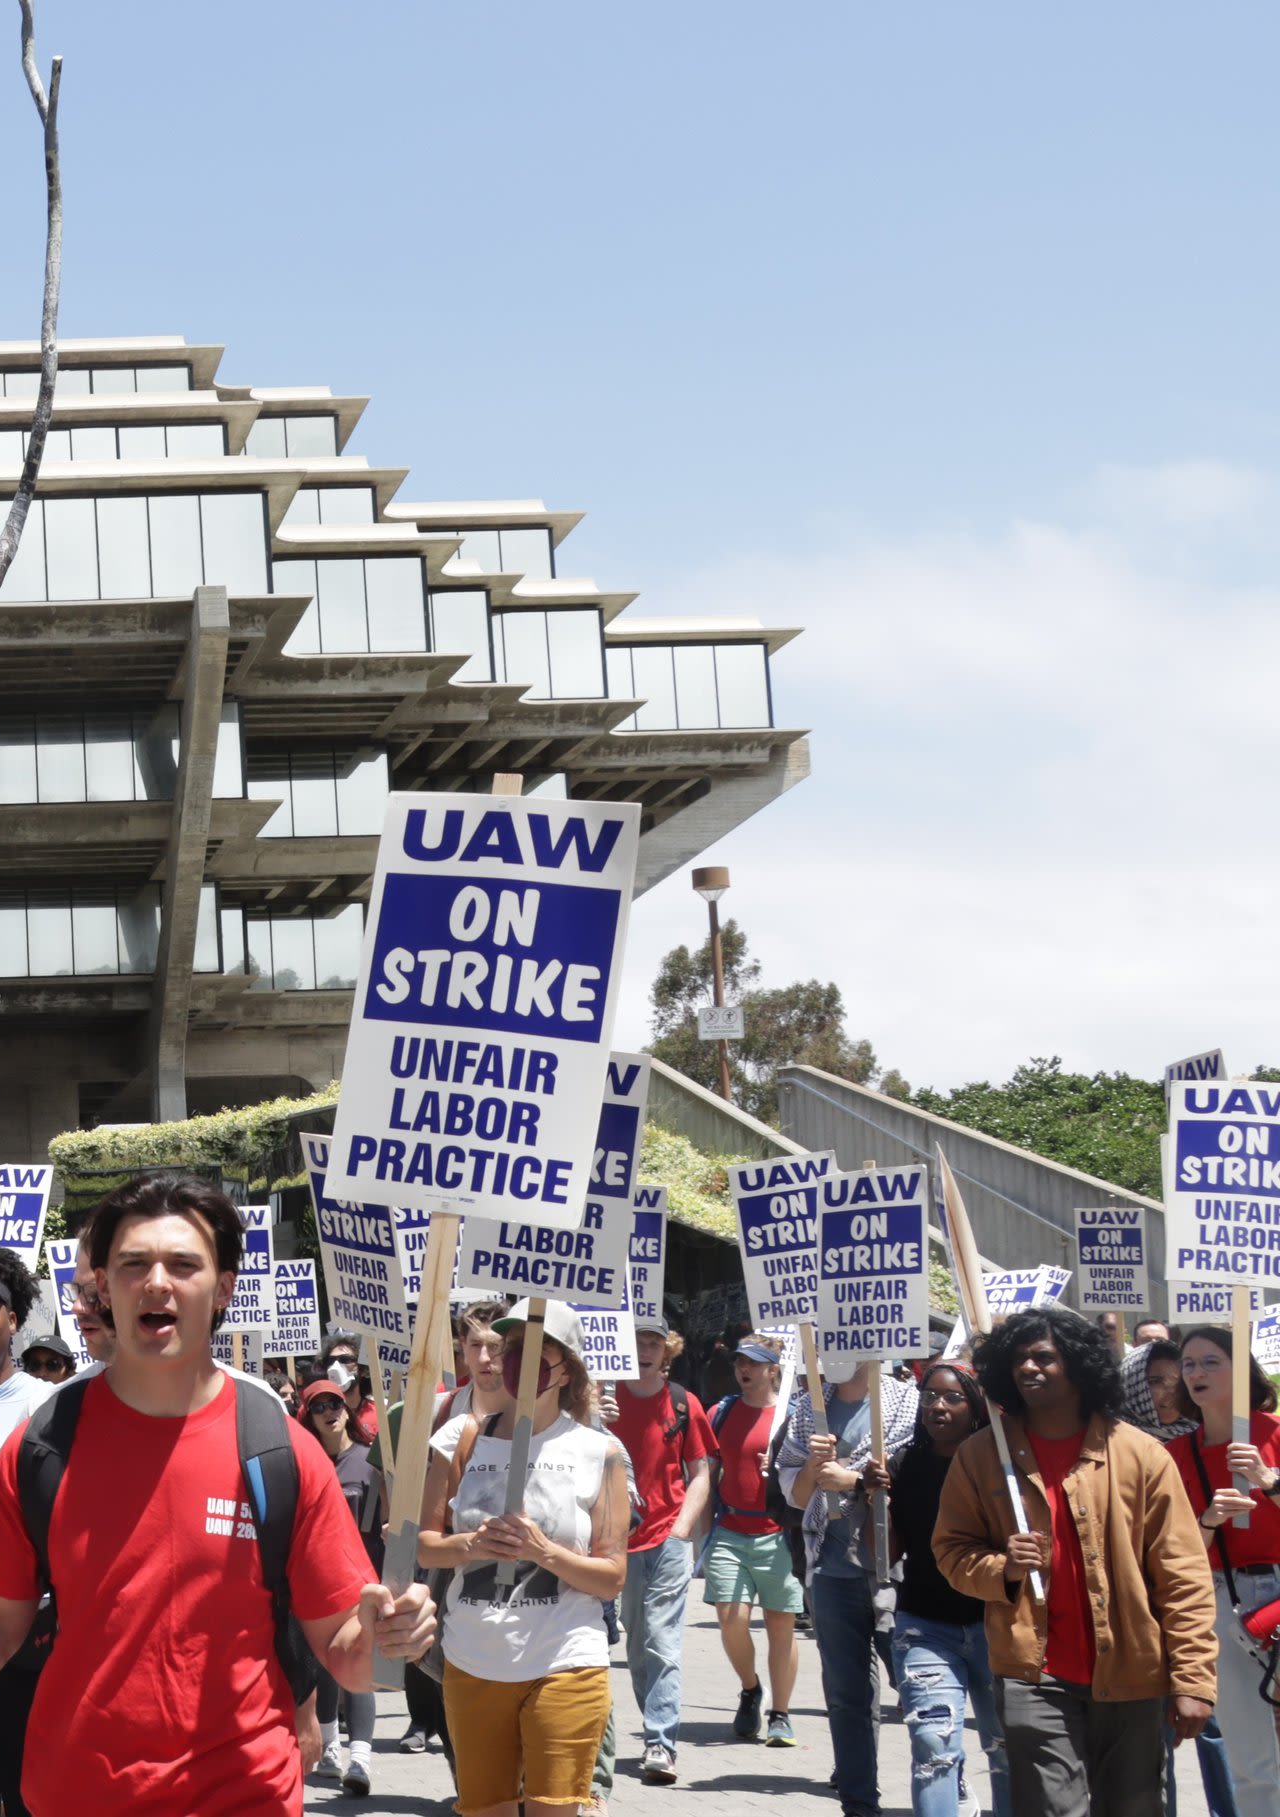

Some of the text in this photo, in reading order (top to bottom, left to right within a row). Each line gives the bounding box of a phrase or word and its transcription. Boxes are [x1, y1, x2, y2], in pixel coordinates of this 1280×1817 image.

[402, 808, 624, 873] UAW
[449, 885, 541, 948] ON
[376, 947, 601, 1023] STRIKE
[390, 1036, 559, 1095] UNFAIR
[1170, 1054, 1219, 1080] UAW
[389, 1087, 540, 1147] LABOR
[1218, 1125, 1270, 1155] ON
[346, 1135, 574, 1204] PRACTICE
[738, 1158, 829, 1192] UAW
[1180, 1155, 1280, 1189] STRIK
[824, 1173, 921, 1208] UAW
[770, 1192, 808, 1219] ON
[321, 1208, 393, 1248] STRIKE
[851, 1212, 888, 1241] ON
[1080, 1211, 1139, 1225] UAW
[498, 1222, 594, 1260] LABOR
[748, 1218, 817, 1250] STRIK
[1097, 1229, 1123, 1245] ON
[334, 1250, 388, 1281] UNFAIR
[763, 1254, 817, 1278] UNFAI
[824, 1242, 920, 1273] STRIKE
[1081, 1246, 1141, 1262] STRIKE
[275, 1263, 312, 1278] AW
[471, 1250, 615, 1295] PRACTICE
[1089, 1268, 1135, 1279] UNFAIR
[276, 1283, 297, 1296] ON
[339, 1276, 389, 1306] LABOR
[770, 1275, 817, 1297] LABO
[834, 1280, 908, 1304] UNFAIR
[988, 1288, 1017, 1302] ON
[1093, 1280, 1133, 1292] LABOR
[277, 1297, 315, 1313] RIKE
[759, 1295, 817, 1320] PRACT
[1084, 1293, 1143, 1304] PRACTICE
[1177, 1290, 1258, 1313] PRACTE
[224, 1309, 271, 1324] ACTICE
[277, 1317, 310, 1327] NFAIR
[333, 1297, 404, 1333] PRACTICE
[581, 1316, 618, 1332] FAIR
[838, 1304, 903, 1327] LABOR
[264, 1340, 318, 1352] PRACTICE
[271, 1329, 309, 1340] LABOR
[583, 1336, 616, 1352] BOR
[824, 1327, 921, 1352] PRACTICE
[583, 1355, 632, 1371] CTICE
[469, 1462, 578, 1473] AGE AAINST
[207, 1497, 236, 1516] UAW
[205, 1517, 234, 1536] UAW
[489, 1595, 560, 1609] MCHINE
